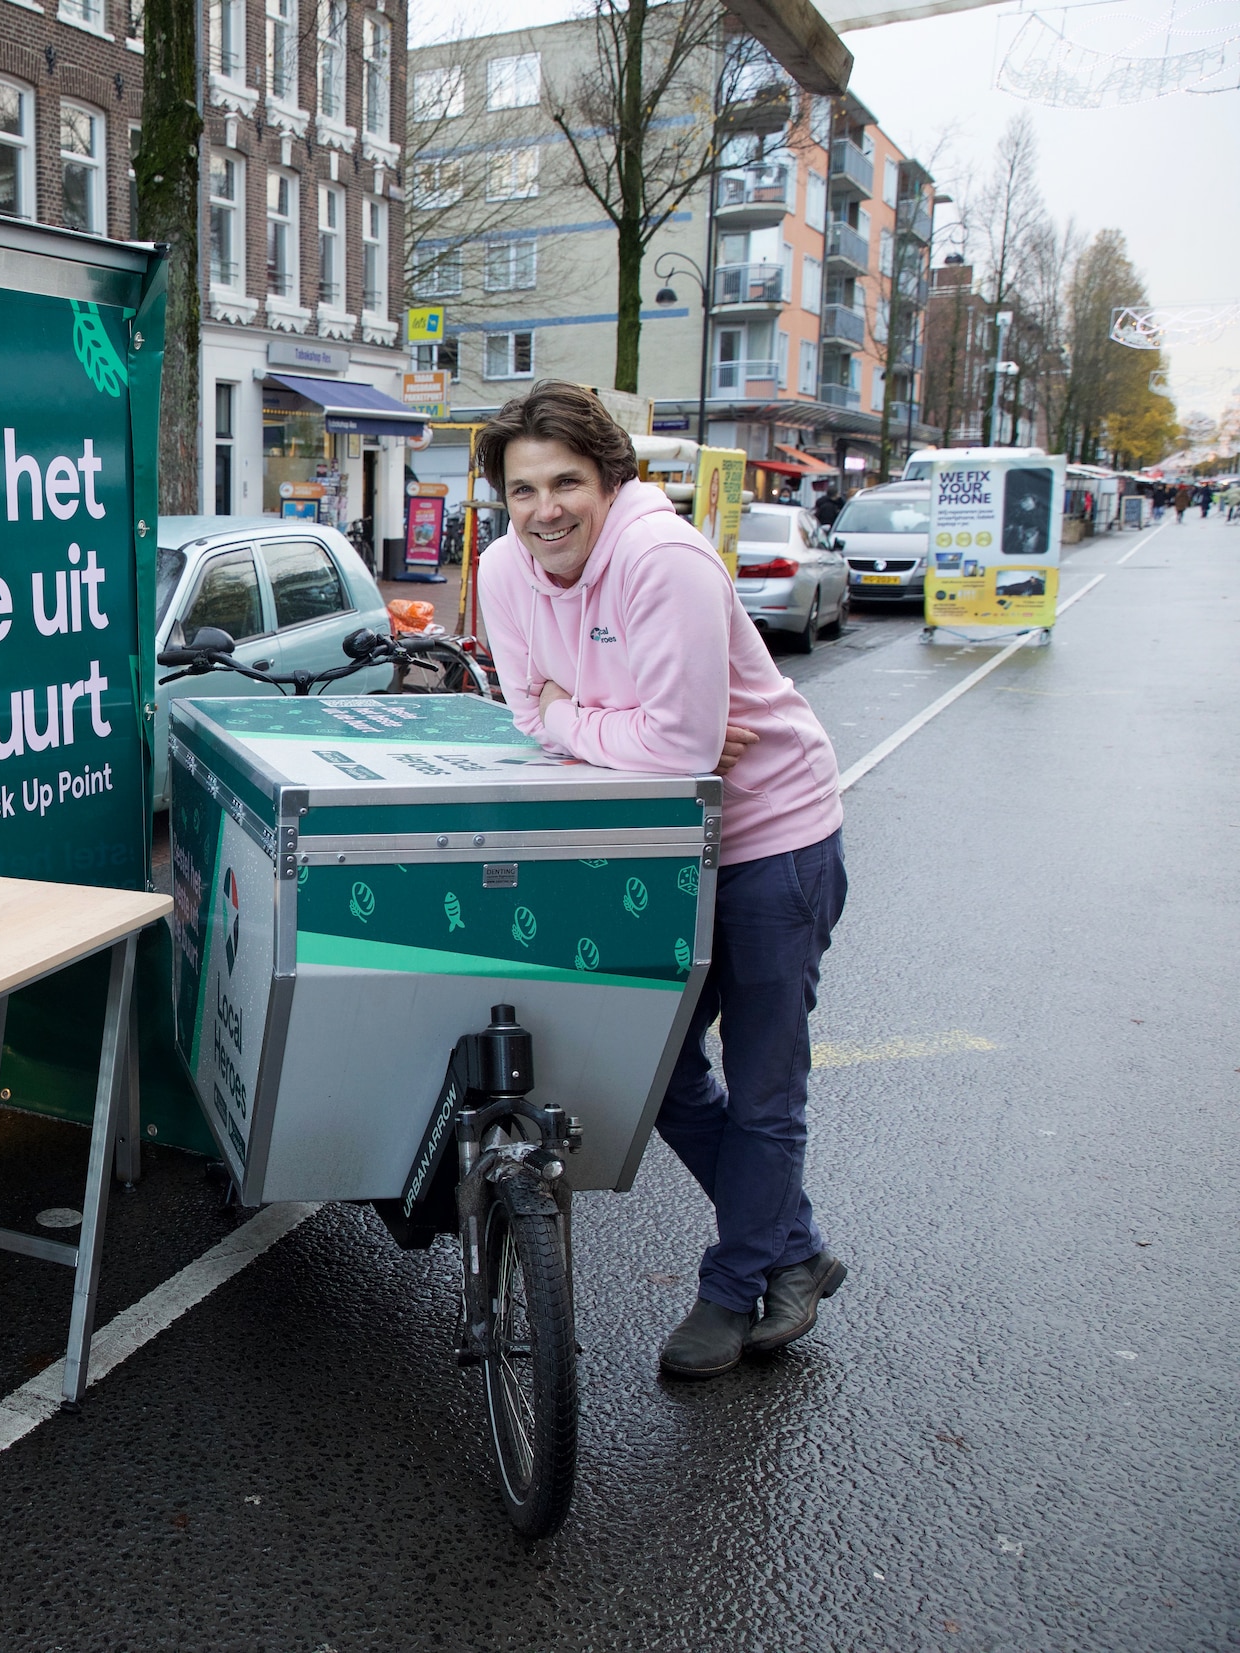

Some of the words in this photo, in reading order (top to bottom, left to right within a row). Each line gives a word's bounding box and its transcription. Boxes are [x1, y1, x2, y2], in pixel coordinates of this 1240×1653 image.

[4, 427, 106, 521] het
[938, 493, 992, 505] PHONE
[939, 483, 982, 494] YOUR
[940, 471, 964, 482] WE
[967, 470, 991, 482] FIX
[32, 543, 109, 636] uit
[23, 778, 53, 816] Up
[59, 763, 113, 803] Point
[486, 868, 516, 876] DENTING
[217, 971, 243, 1055] Local
[214, 1019, 247, 1120] Heroes
